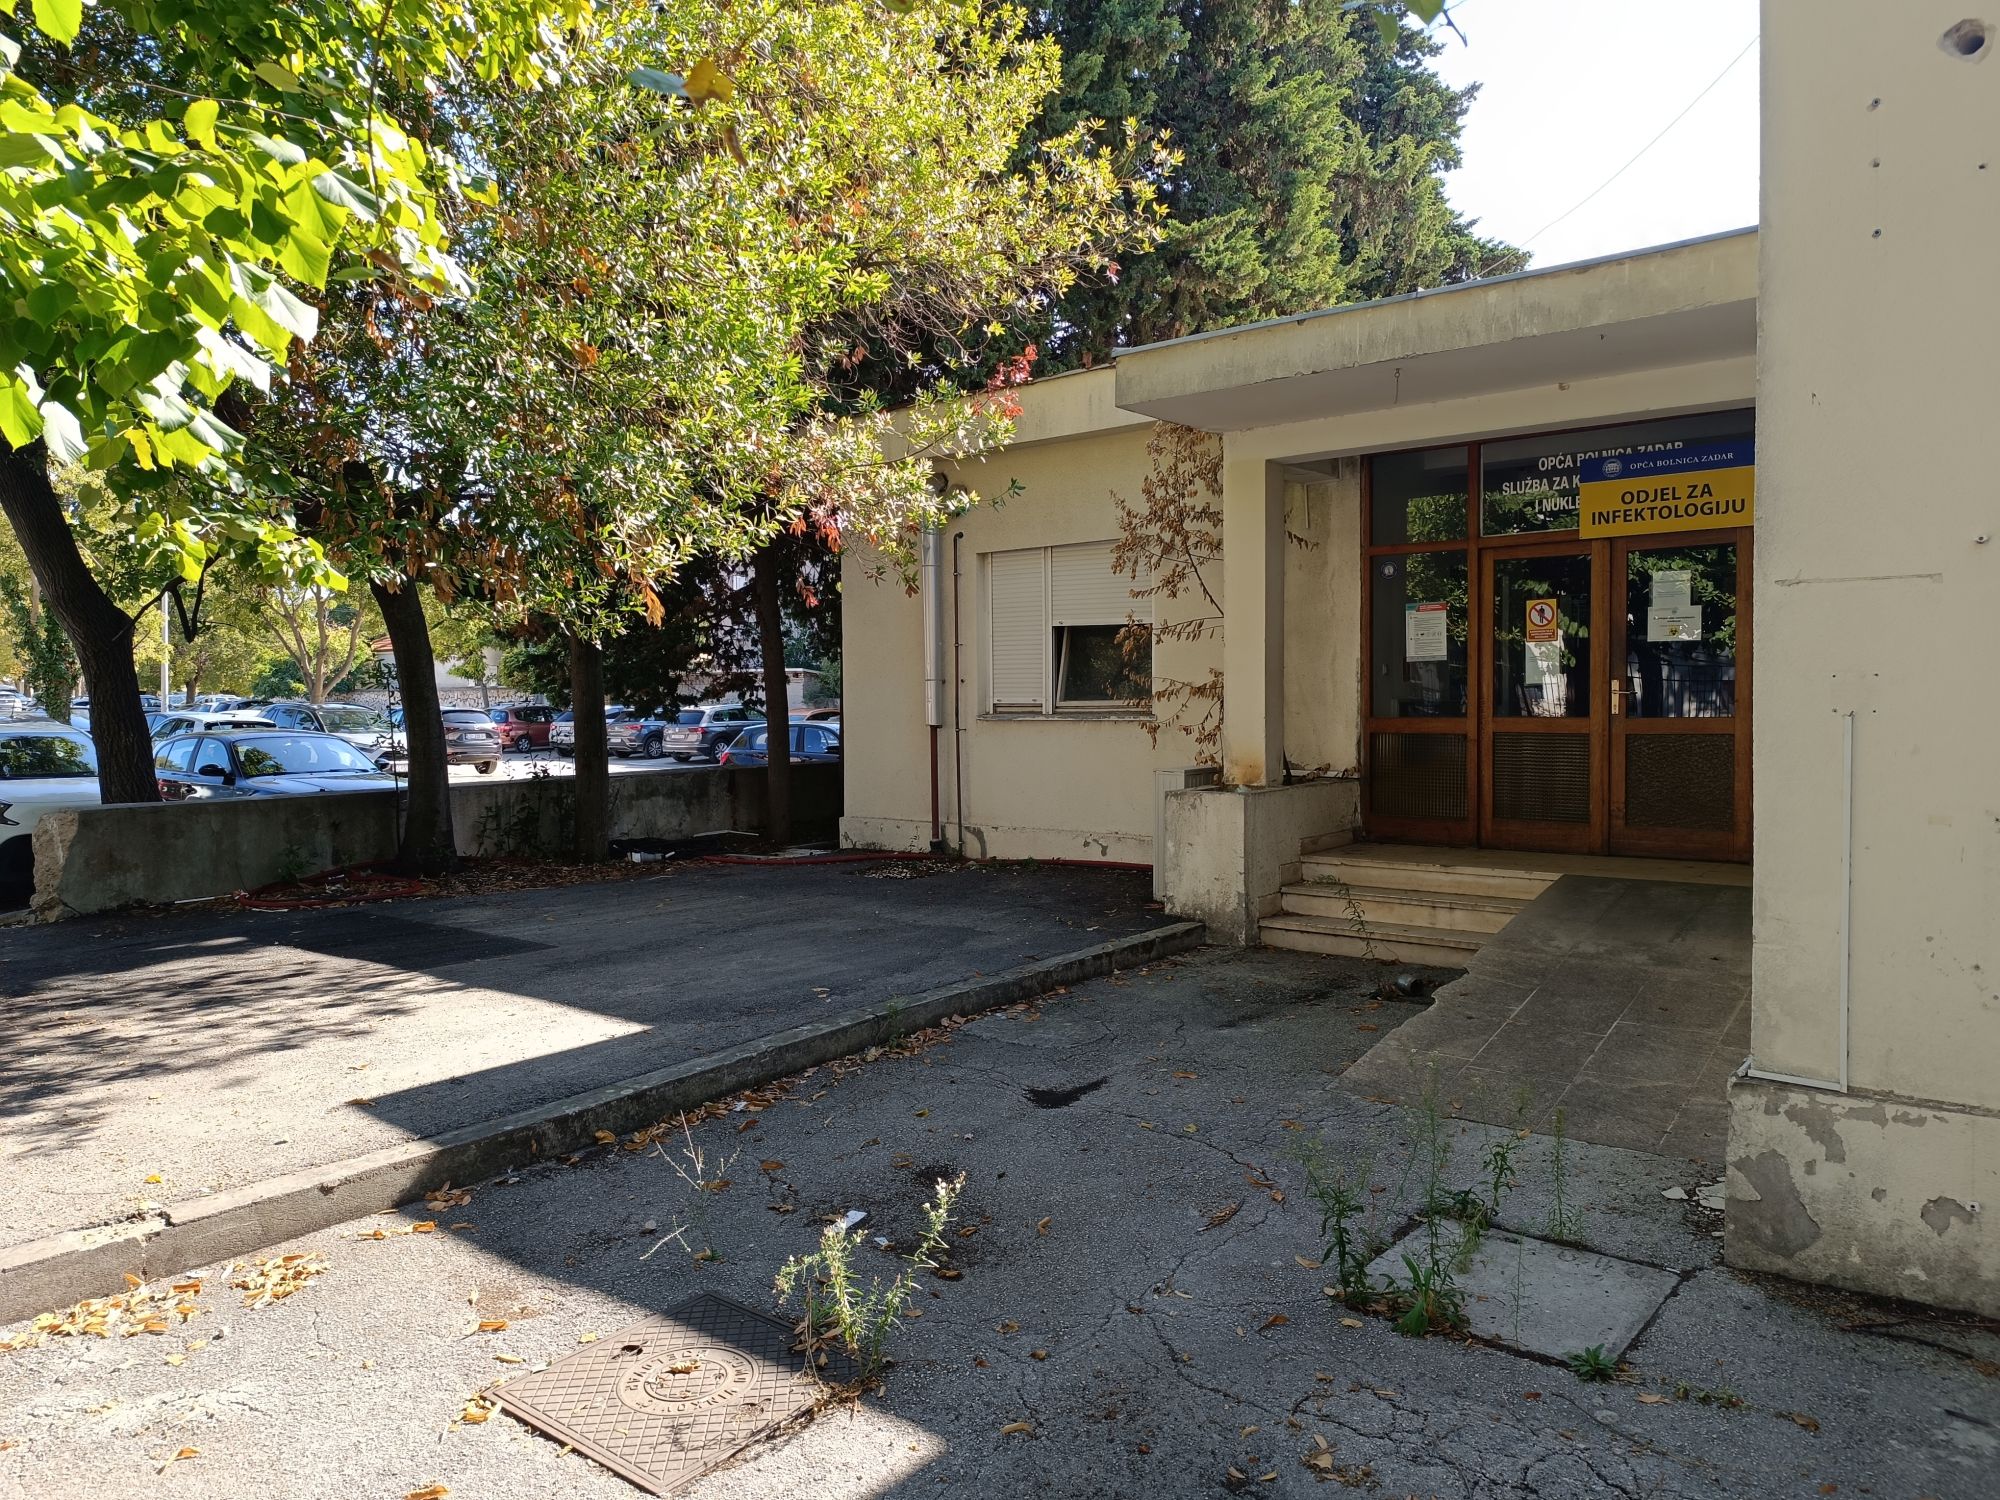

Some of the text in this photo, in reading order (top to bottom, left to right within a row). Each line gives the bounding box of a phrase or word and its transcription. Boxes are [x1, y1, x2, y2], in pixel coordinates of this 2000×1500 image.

[1538, 452, 1574, 471] OPĆA
[1629, 461, 1655, 471] OPĆA
[1656, 455, 1700, 468] BOLNICA
[1701, 452, 1735, 463] ZADAR
[1502, 476, 1550, 496] SLUŽBA
[1552, 475, 1569, 490] ZA
[1620, 483, 1714, 505] ODJEL ZA
[1590, 498, 1746, 526] INFEKTOLOGIJU
